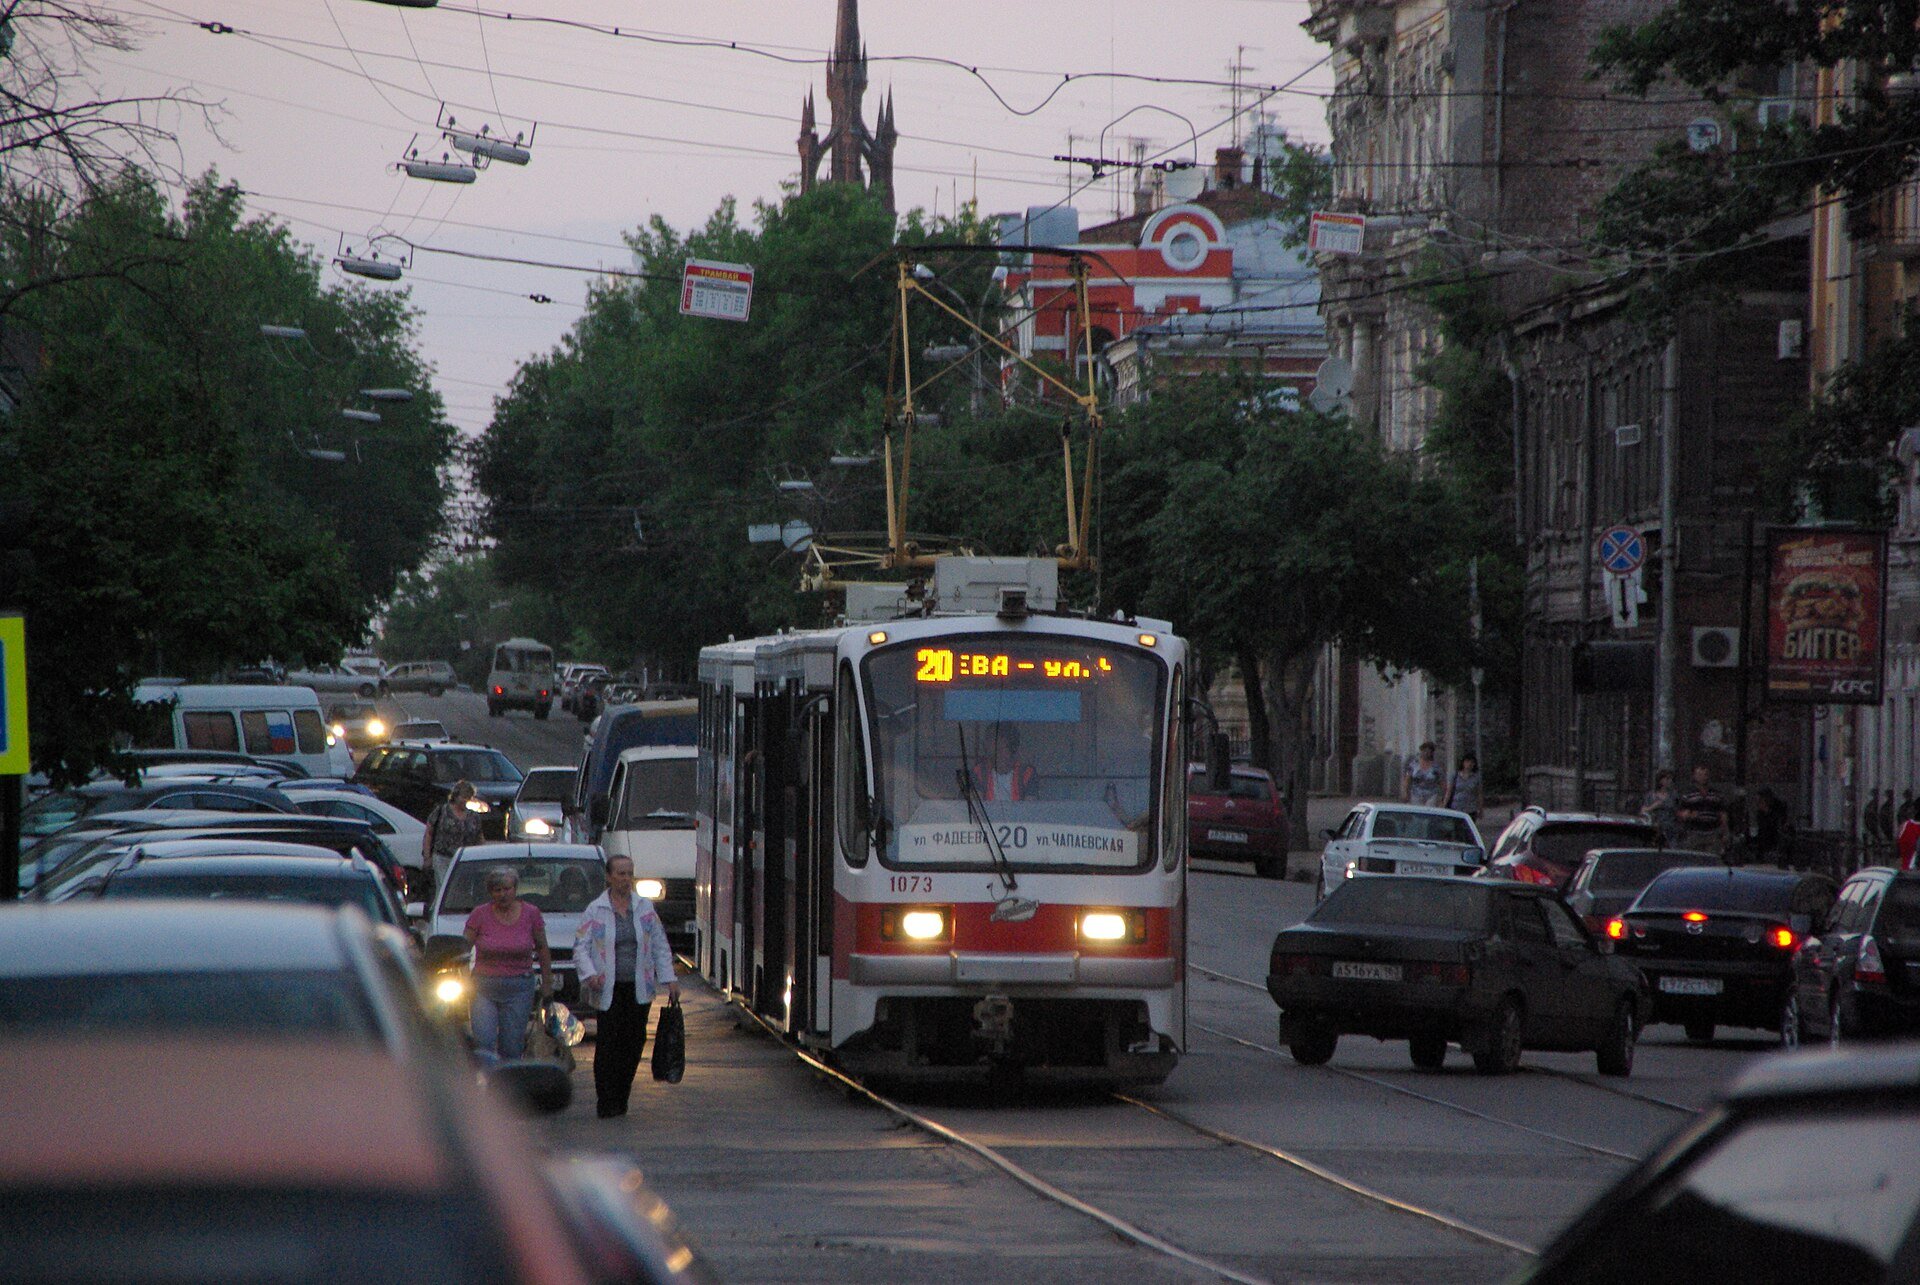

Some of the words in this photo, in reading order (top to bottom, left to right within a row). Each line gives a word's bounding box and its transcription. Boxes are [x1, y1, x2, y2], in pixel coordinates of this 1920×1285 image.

[700, 268, 739, 281] ТРАМВАЙ
[917, 649, 953, 682] 20
[1830, 680, 1873, 695] KFC
[998, 825, 1028, 849] 20
[1052, 832, 1124, 853] ЧАПАЕВСКАЯ
[890, 876, 933, 893] 1073
